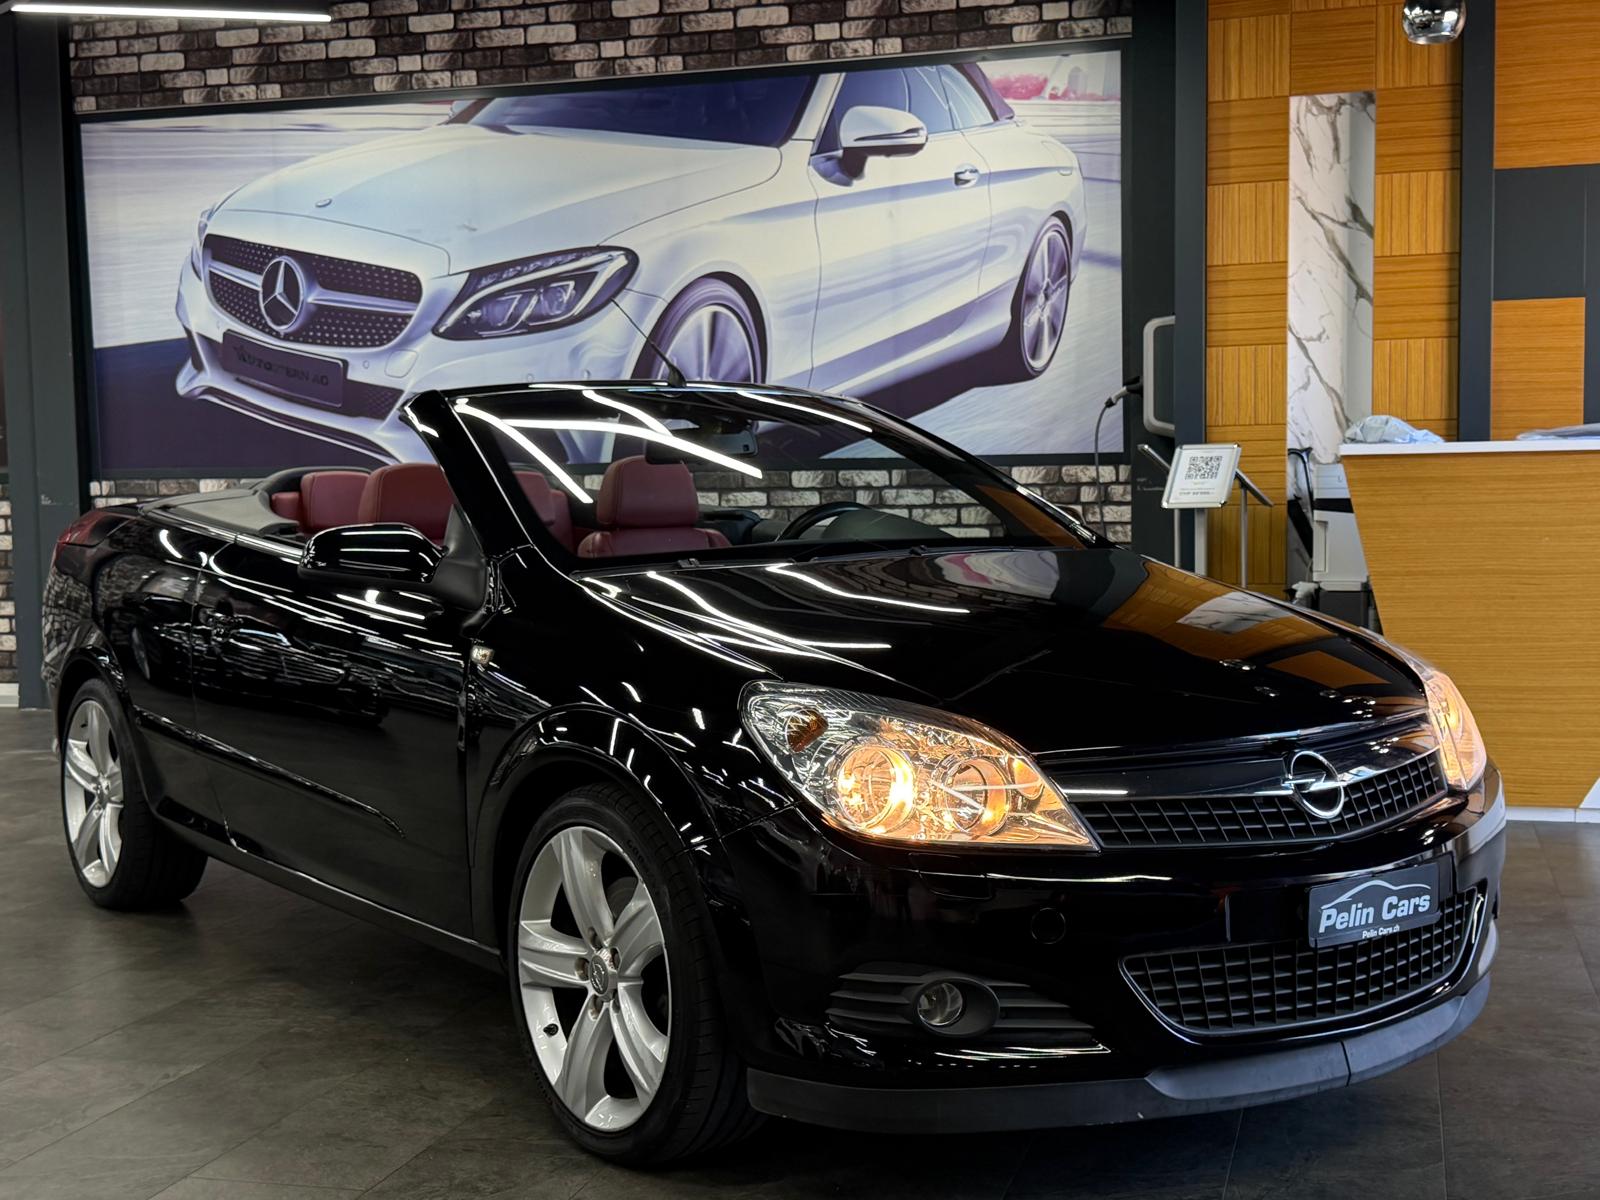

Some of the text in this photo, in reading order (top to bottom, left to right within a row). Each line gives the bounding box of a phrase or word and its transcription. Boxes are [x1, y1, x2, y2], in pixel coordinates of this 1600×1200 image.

[1318, 894, 1431, 934] Pelin Cars
[1362, 929, 1378, 939] Pelin
